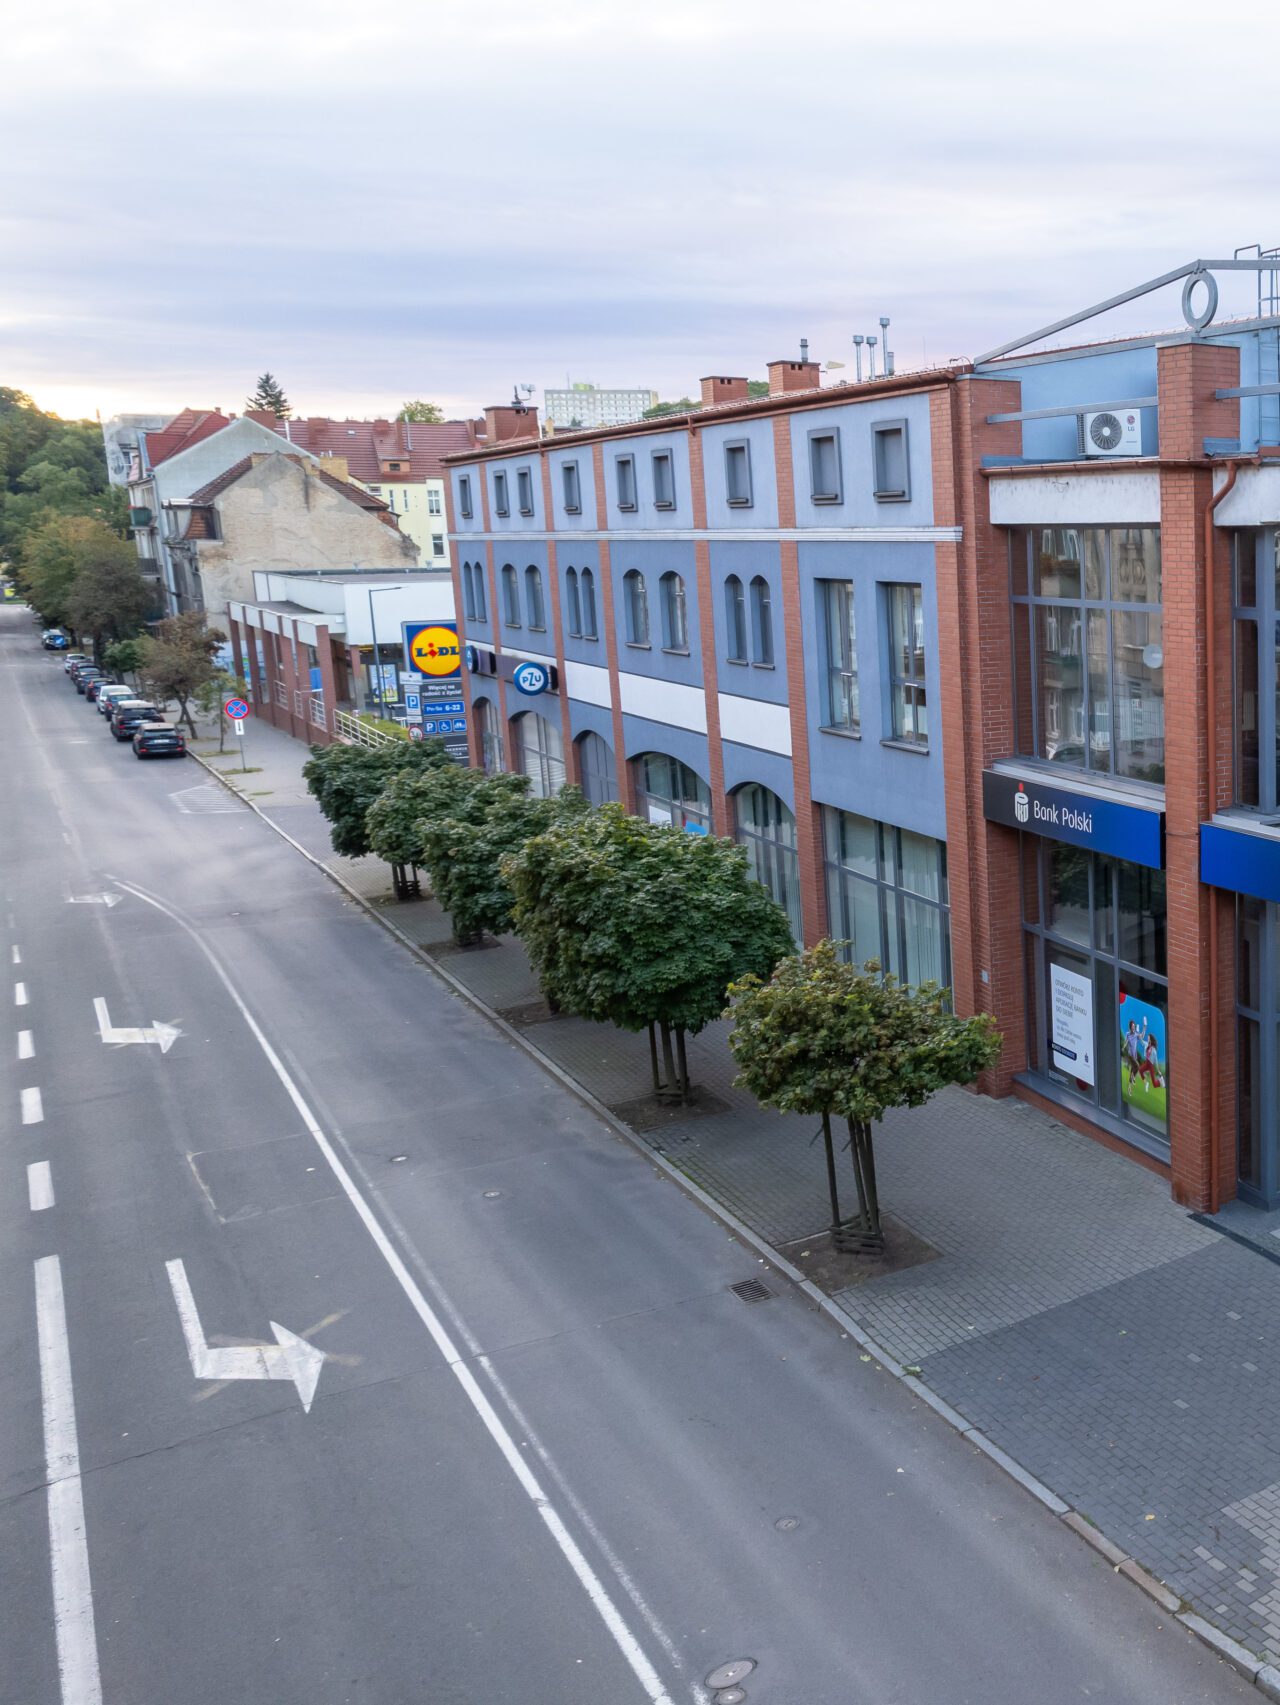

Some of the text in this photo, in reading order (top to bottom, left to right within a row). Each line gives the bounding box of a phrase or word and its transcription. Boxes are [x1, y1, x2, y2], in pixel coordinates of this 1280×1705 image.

[522, 672, 541, 687] PZU
[1033, 800, 1059, 825] Bank
[1062, 807, 1092, 834] Polski
